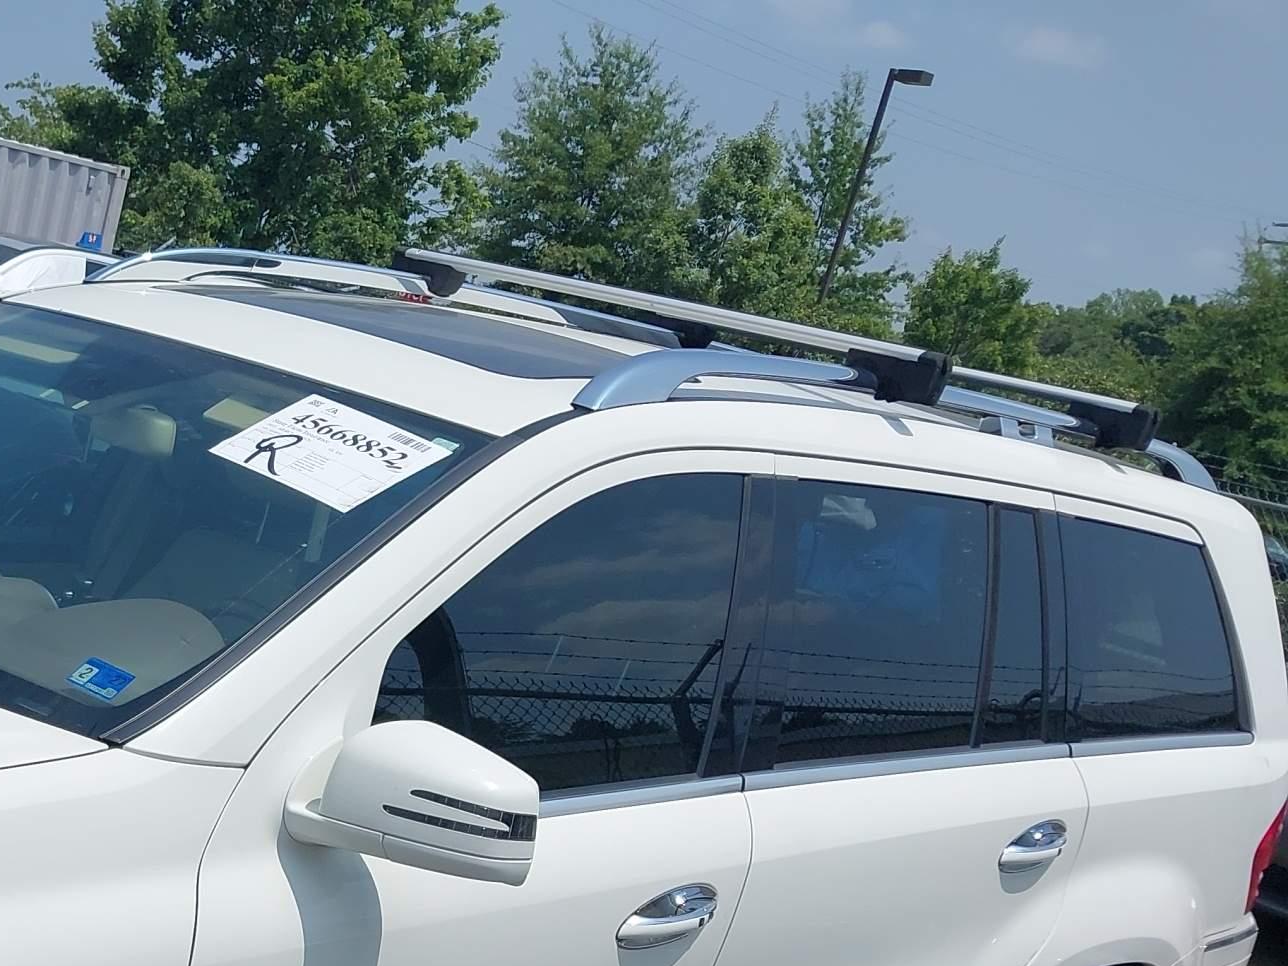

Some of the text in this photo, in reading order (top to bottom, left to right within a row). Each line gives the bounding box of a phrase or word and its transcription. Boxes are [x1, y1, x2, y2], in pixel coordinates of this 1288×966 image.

[244, 434, 303, 476] R
[292, 414, 409, 470] 45668852
[78, 667, 94, 679] 2
